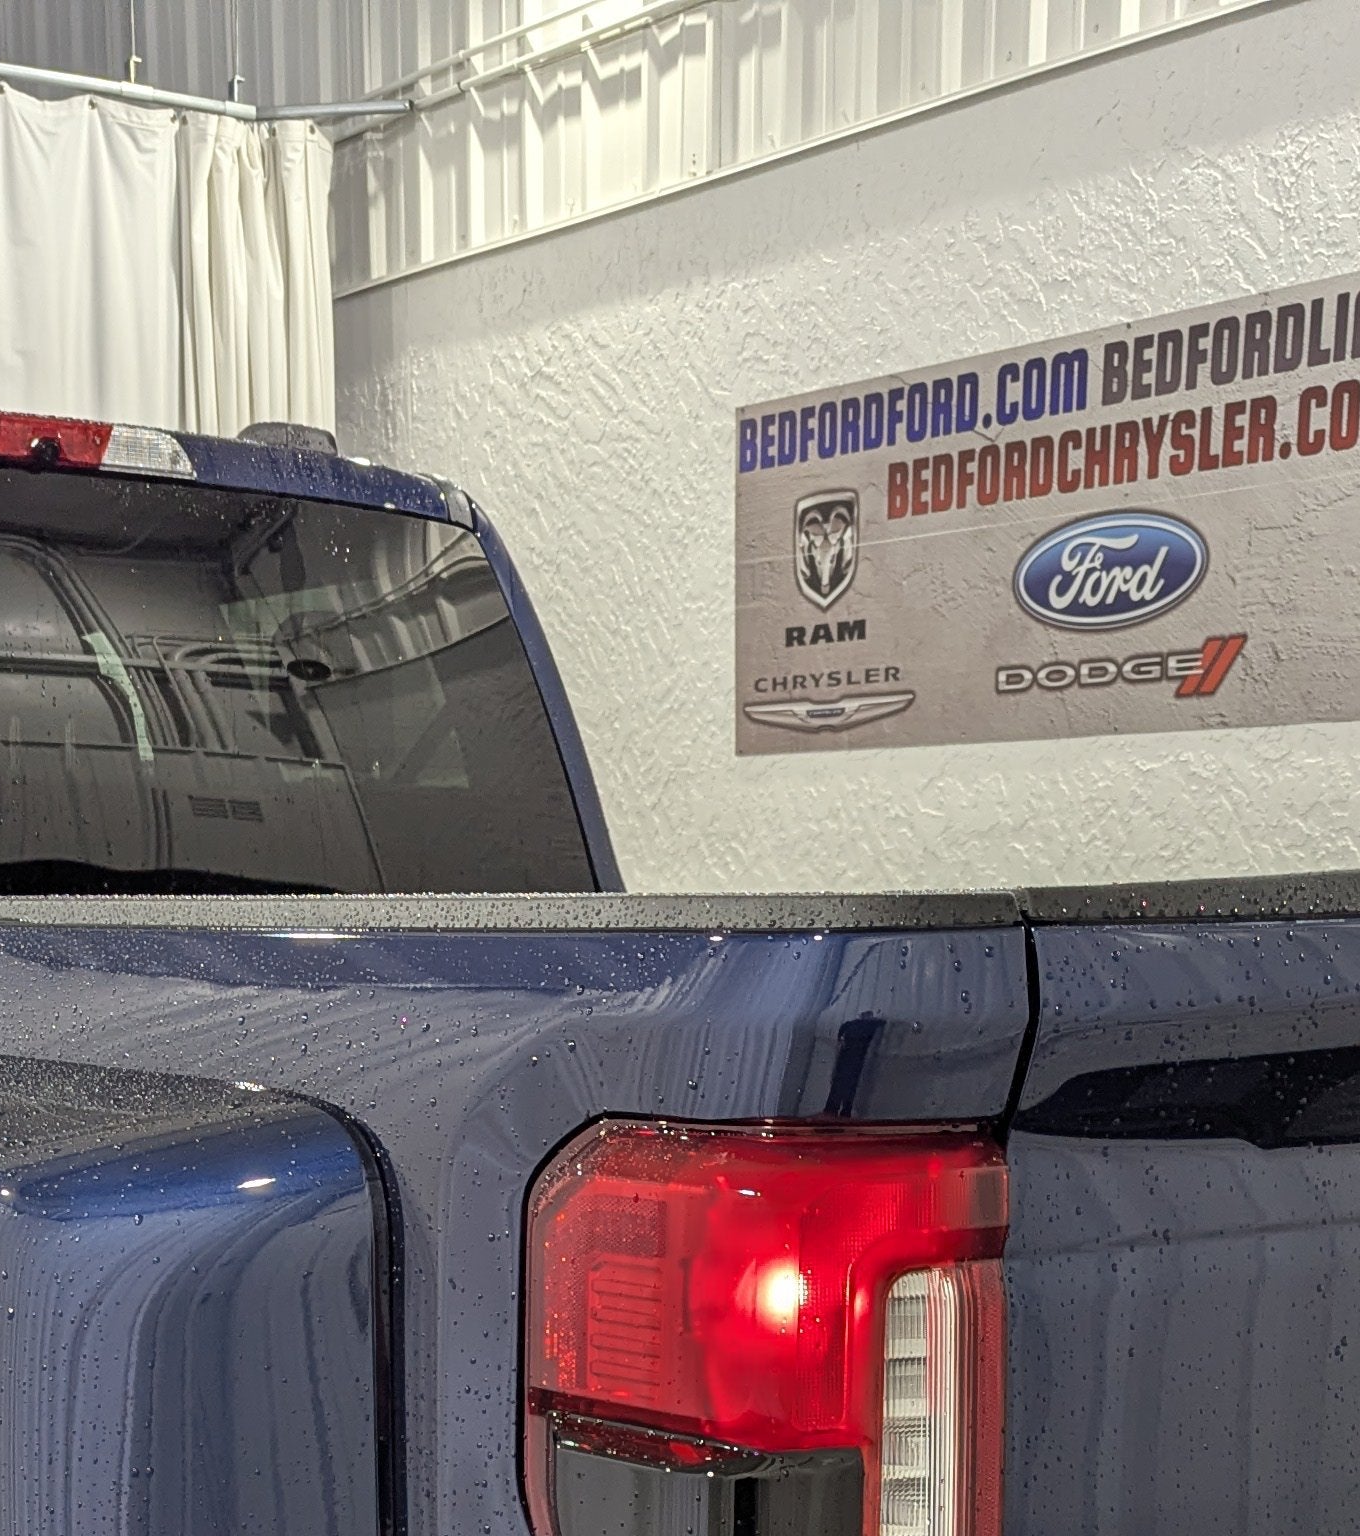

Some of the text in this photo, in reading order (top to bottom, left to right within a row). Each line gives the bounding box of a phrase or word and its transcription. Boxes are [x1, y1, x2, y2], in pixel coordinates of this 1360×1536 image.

[739, 348, 1088, 473] BEDFORDFORD.COM
[1048, 533, 1169, 609] Ford
[785, 618, 867, 648] RAM
[754, 666, 901, 693] CHRYSLER
[996, 650, 1206, 694] DODGE
